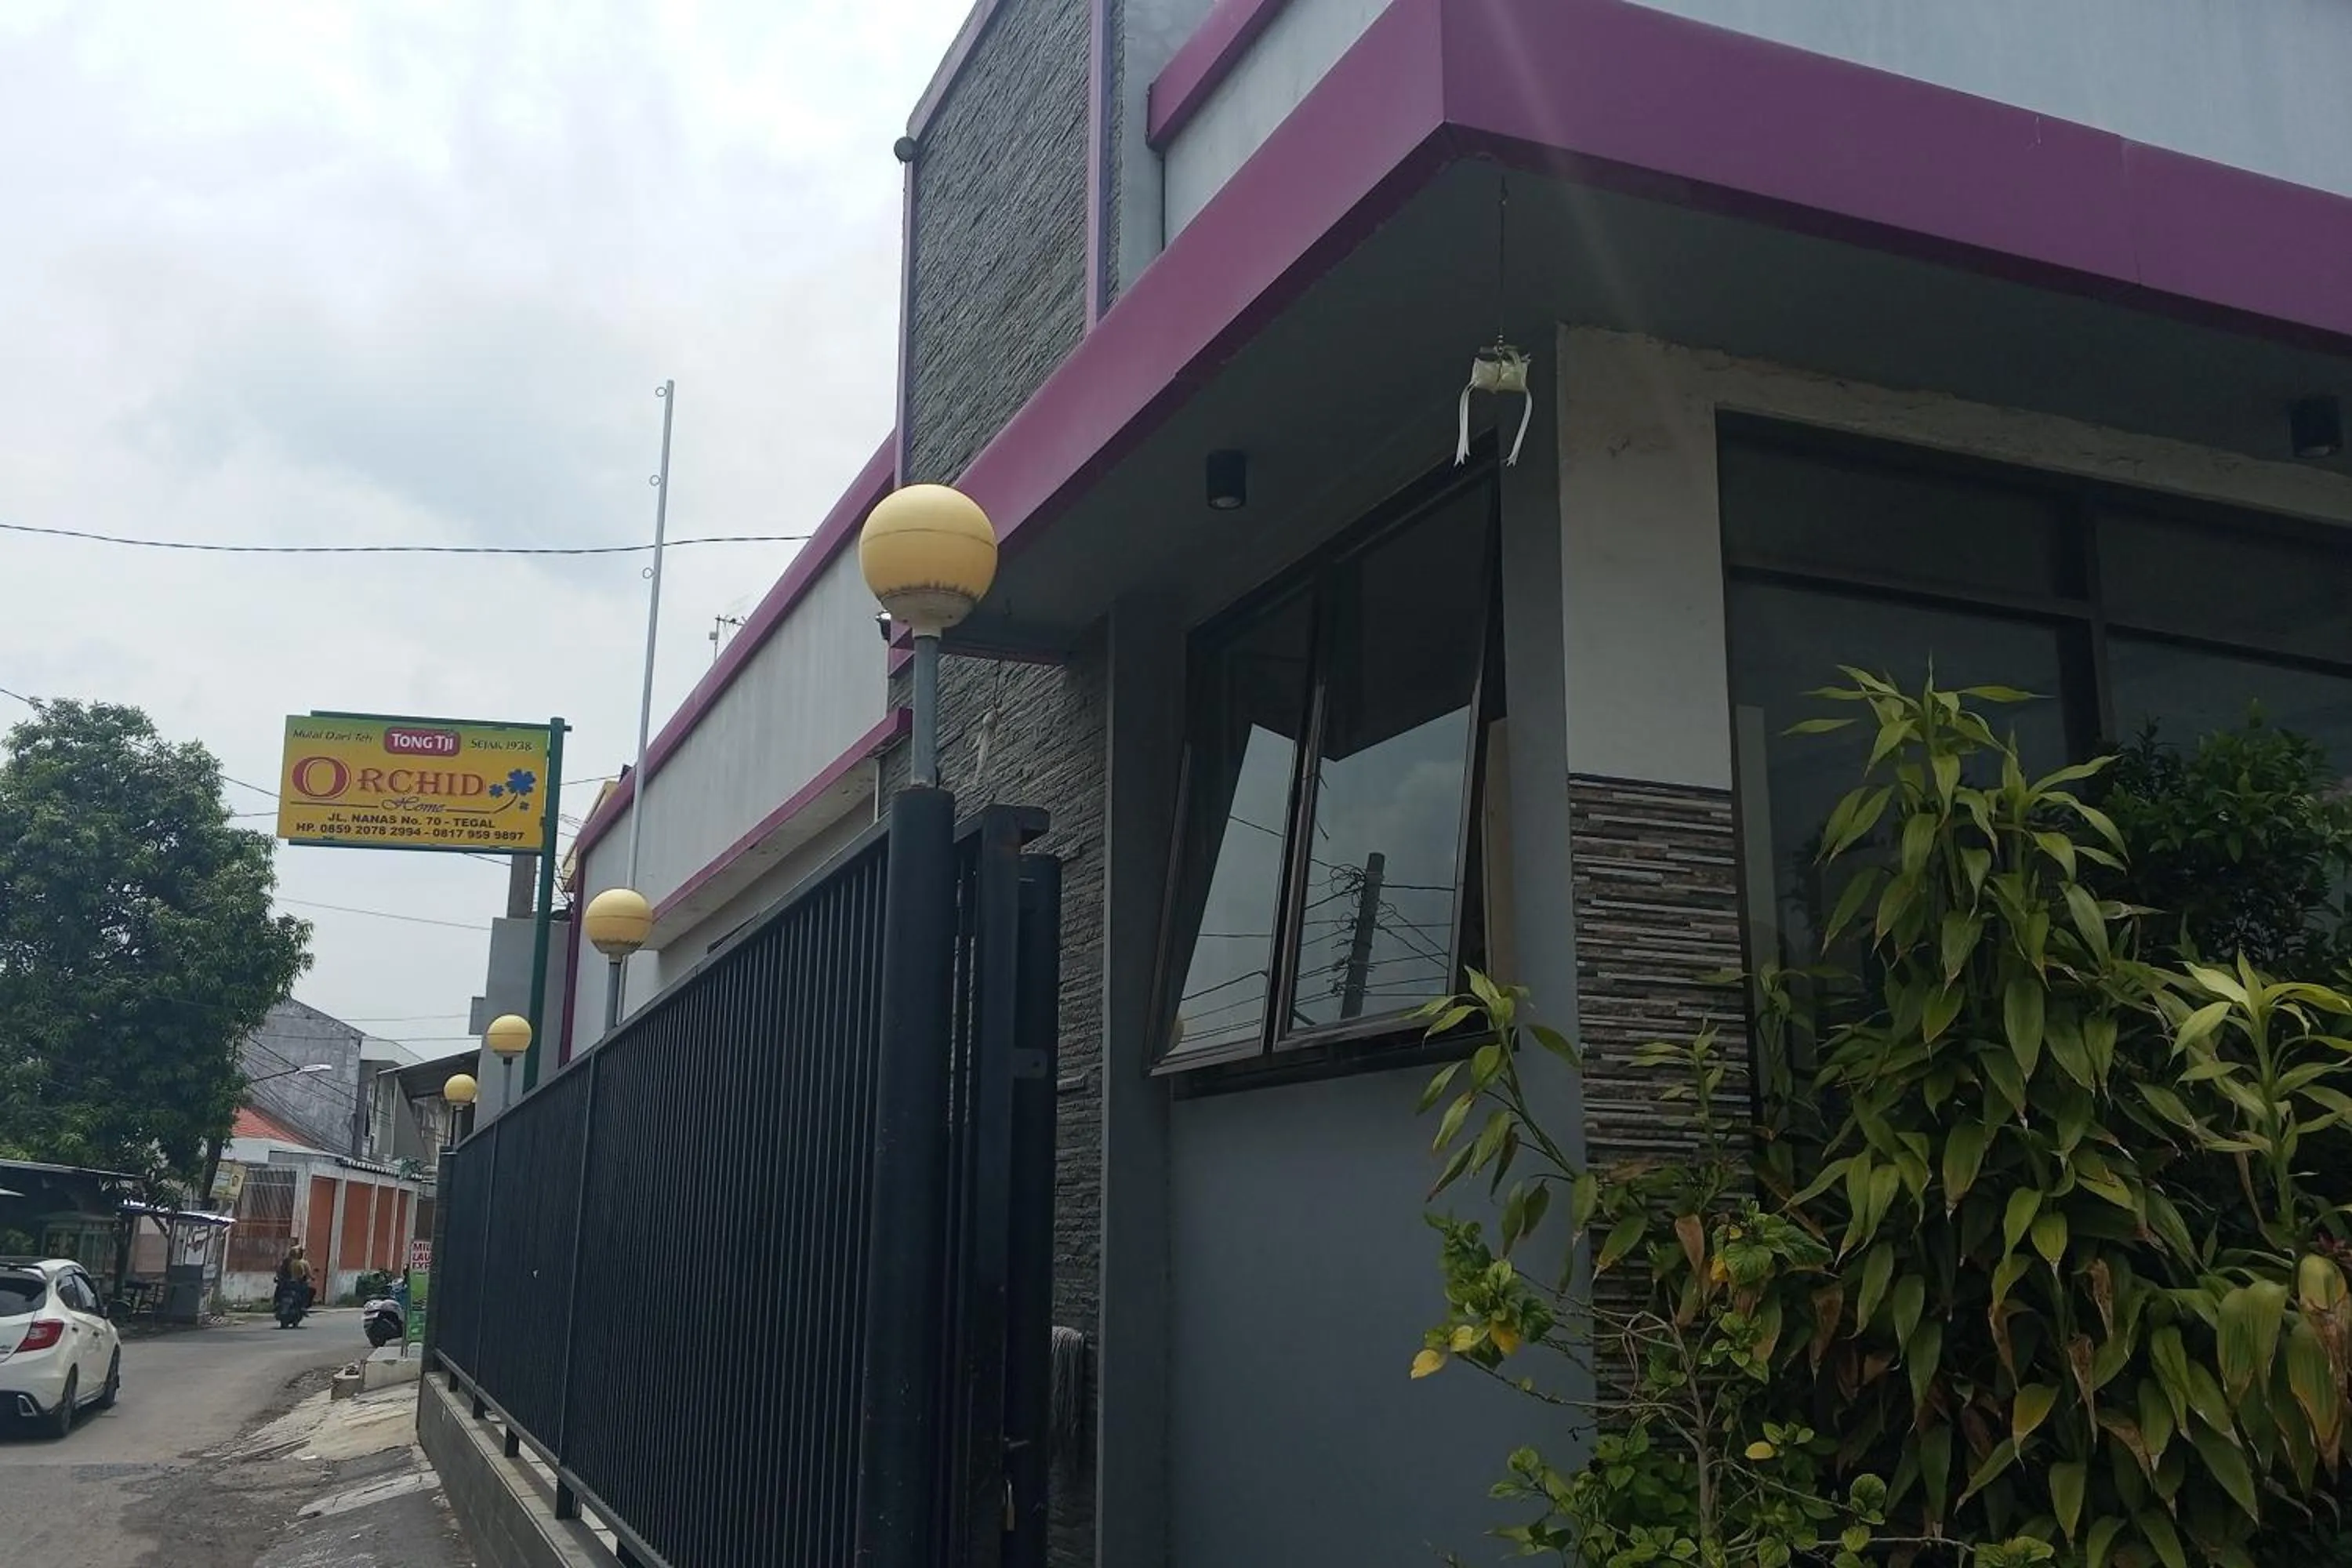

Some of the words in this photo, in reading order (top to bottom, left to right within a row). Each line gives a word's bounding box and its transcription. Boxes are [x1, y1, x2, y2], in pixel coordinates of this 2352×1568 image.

[325, 731, 350, 741] Dari
[355, 733, 373, 742] Teh
[392, 732, 432, 750] TONG
[436, 735, 453, 752] TJI
[506, 740, 532, 751] 1938
[291, 757, 486, 799] ORCHID
[381, 796, 445, 812] Home
[328, 812, 347, 822] JL.
[351, 814, 397, 824] NANAS
[401, 816, 422, 826] No.
[426, 817, 441, 826] 70
[453, 818, 496, 828] TEGAL
[296, 823, 315, 832] HP.
[320, 824, 351, 833] 0859
[355, 826, 386, 835] 2078
[390, 827, 421, 836] 2994
[433, 828, 463, 838] 0817
[467, 830, 490, 839] 959
[494, 831, 524, 840] 9897
